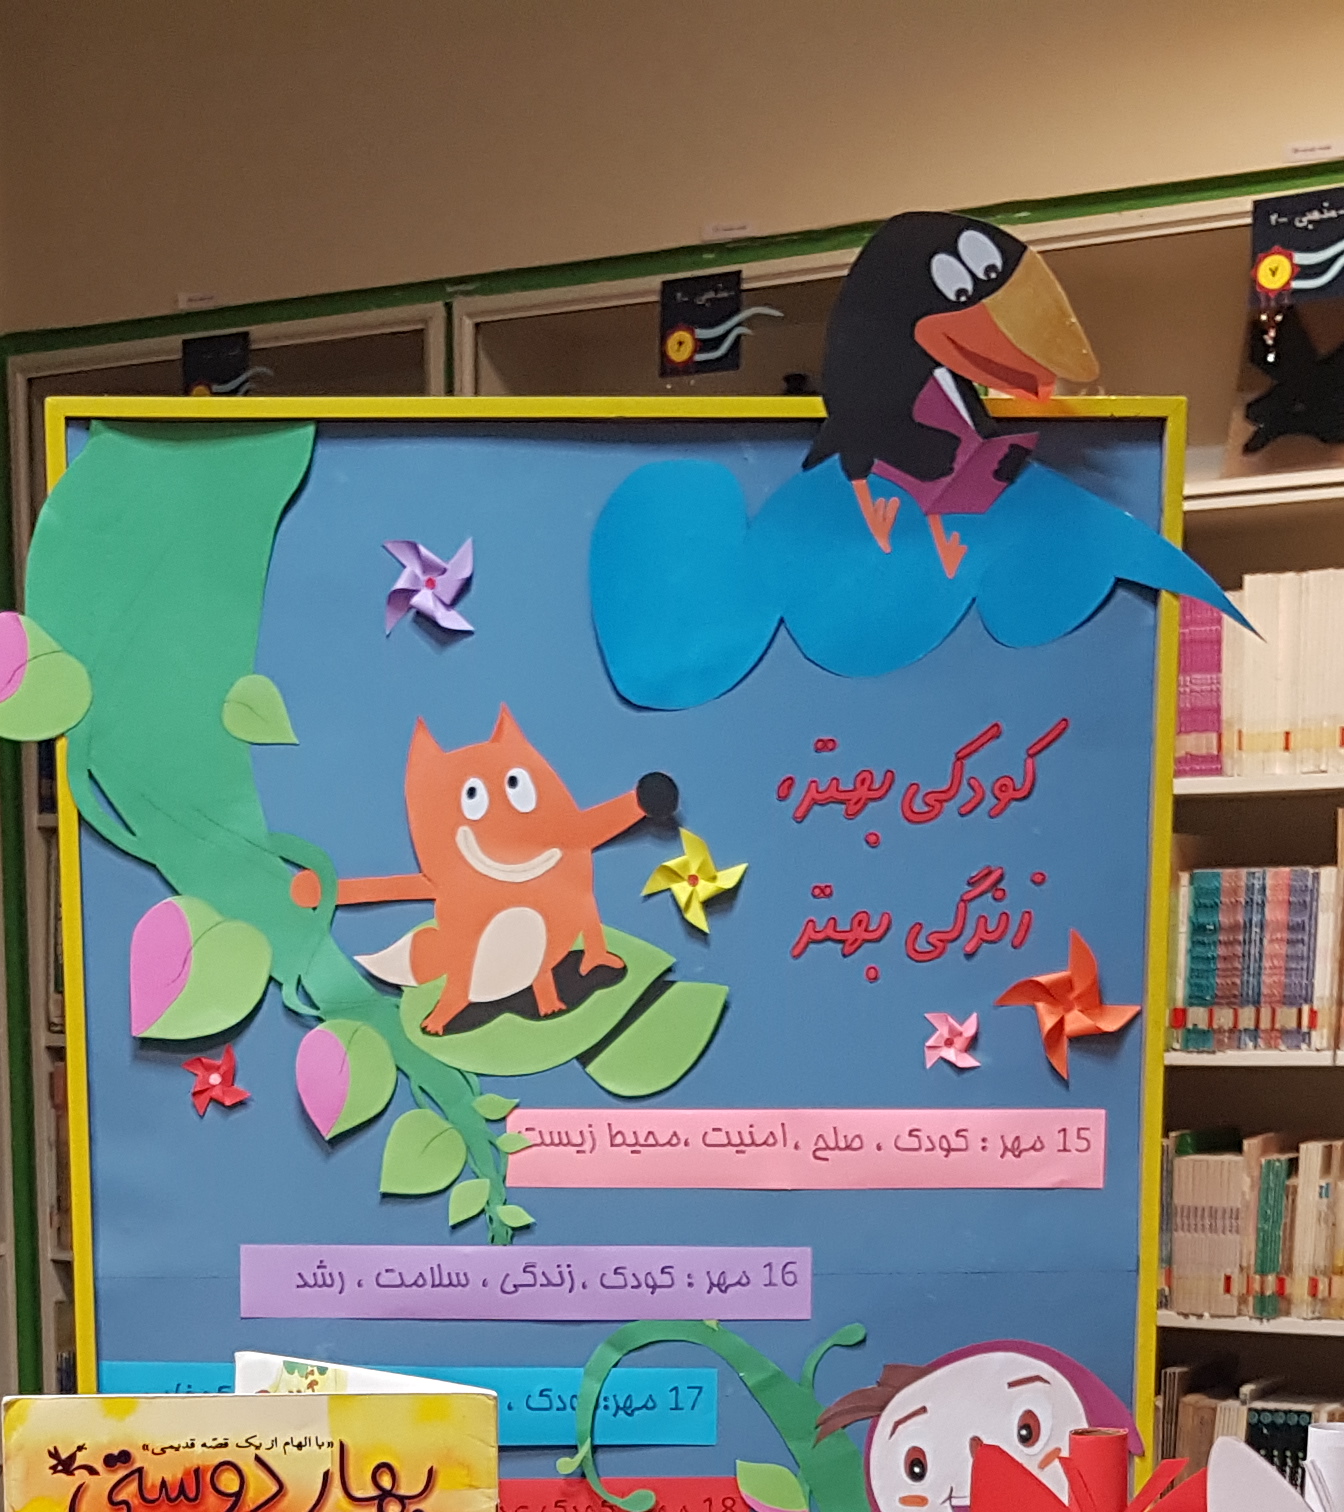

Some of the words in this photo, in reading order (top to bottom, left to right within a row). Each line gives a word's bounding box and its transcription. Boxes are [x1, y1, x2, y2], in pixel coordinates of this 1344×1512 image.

[1268, 265, 1280, 279] ۷
[901, 717, 1071, 825] کودکی
[905, 865, 1047, 964] زندگی
[791, 883, 893, 983] بهتر
[811, 1127, 865, 1162] صلح
[893, 1127, 970, 1160] کودک
[998, 1131, 1045, 1160] مهر
[1056, 1126, 1092, 1153] 15
[295, 1259, 345, 1291] رشد
[375, 1265, 470, 1290] سلامت
[599, 1265, 675, 1296] کودک
[705, 1269, 751, 1296] مهر
[761, 1261, 798, 1288] 16
[668, 1385, 704, 1411] 17
[235, 1434, 263, 1450] یک
[264, 1436, 278, 1451] از
[282, 1436, 312, 1456] الهام
